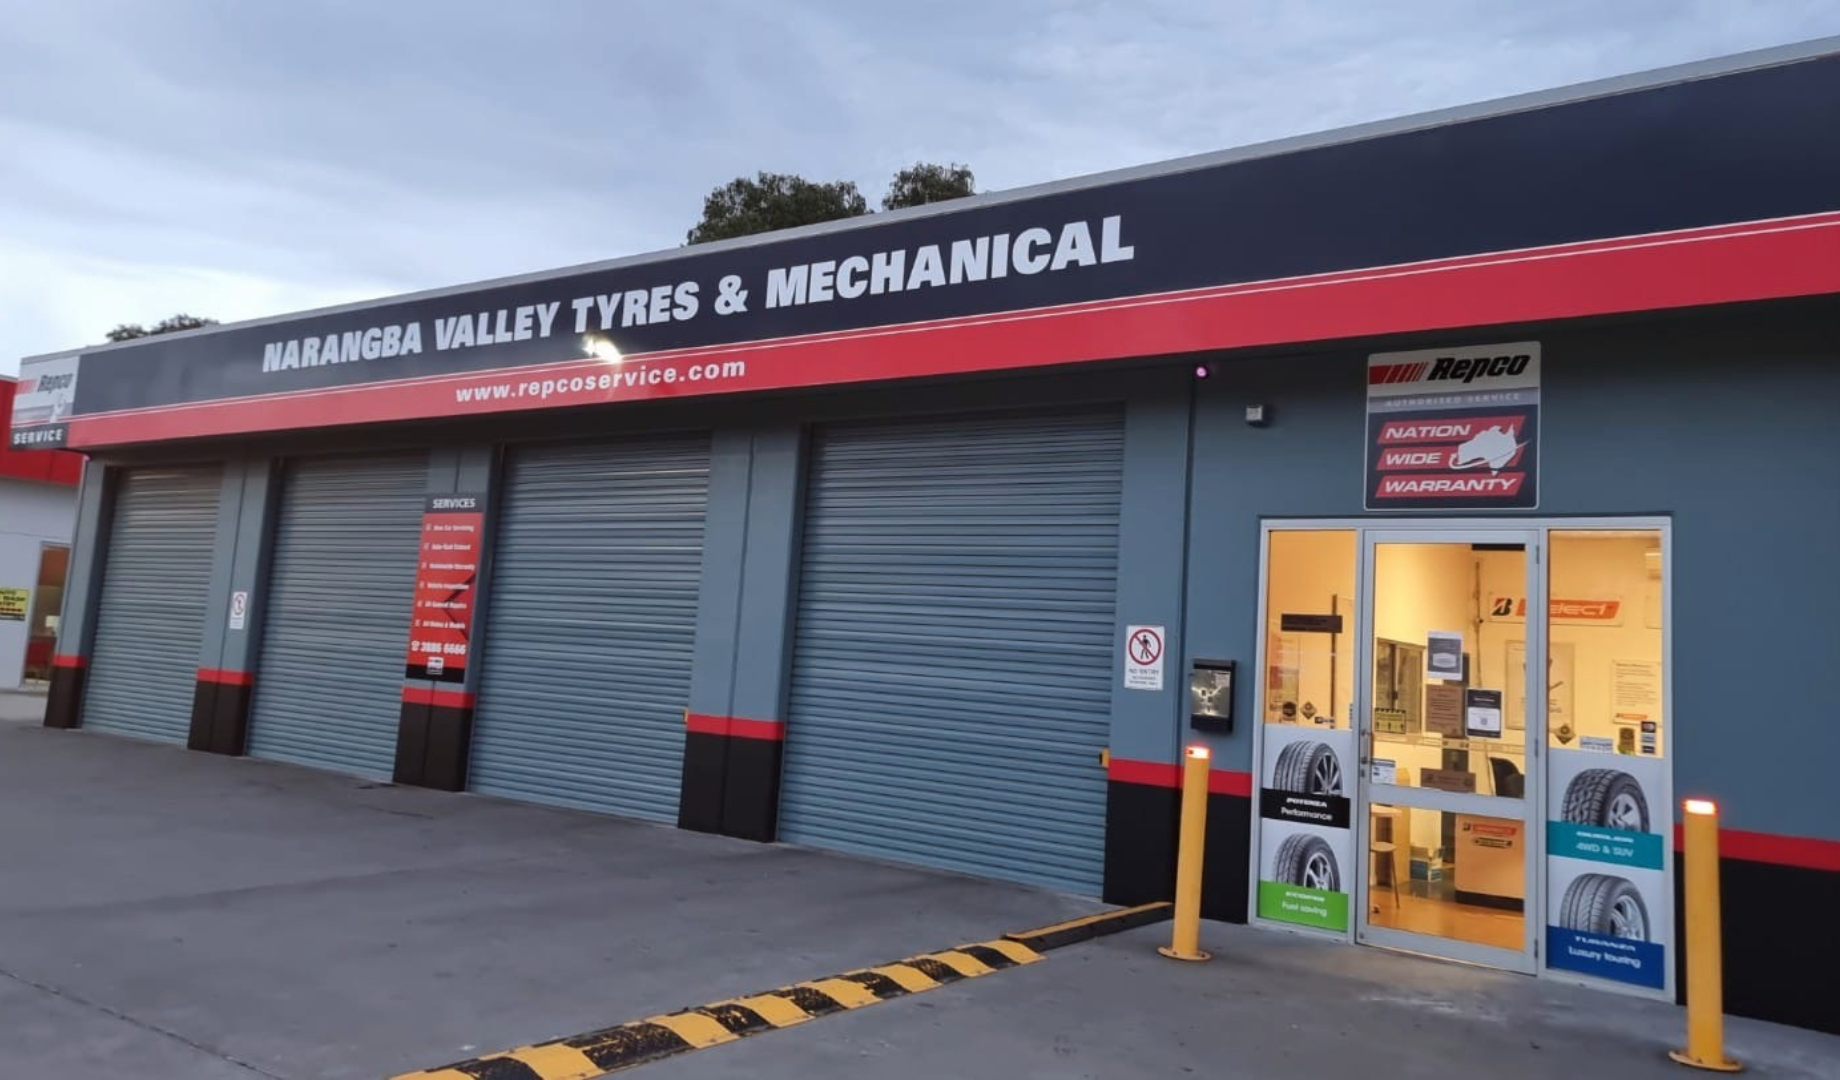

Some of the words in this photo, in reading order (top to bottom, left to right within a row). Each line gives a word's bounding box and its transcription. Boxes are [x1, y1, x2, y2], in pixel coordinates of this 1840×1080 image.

[262, 322, 422, 373] NARANGBA
[435, 302, 561, 351] VALLEY
[571, 281, 699, 333] TYRES
[714, 274, 749, 316] &
[765, 215, 1135, 309] MECHANICAL
[1427, 354, 1531, 384] Repco
[455, 360, 745, 403] www.repcoservice.com
[13, 428, 63, 445] SERVICE
[1385, 424, 1472, 439] NATION
[1385, 452, 1443, 465] WIDE
[1384, 478, 1517, 493] WARRANTY
[432, 498, 476, 509] SERVICES
[1281, 806, 1333, 821] Performance
